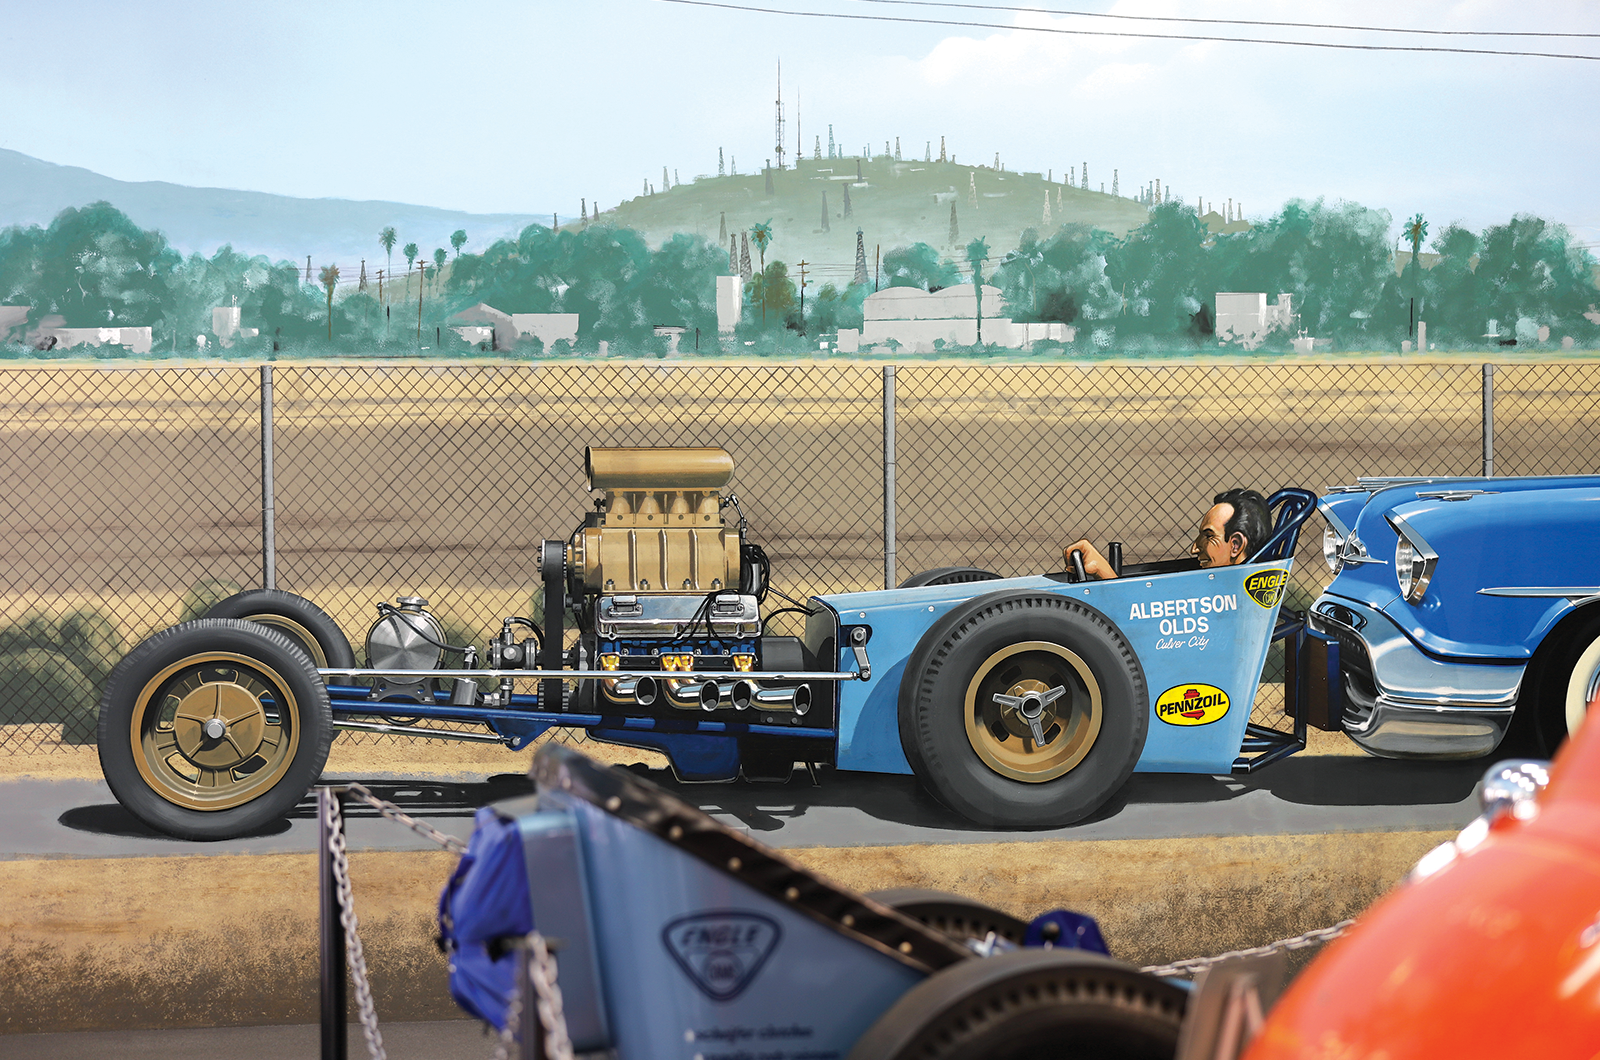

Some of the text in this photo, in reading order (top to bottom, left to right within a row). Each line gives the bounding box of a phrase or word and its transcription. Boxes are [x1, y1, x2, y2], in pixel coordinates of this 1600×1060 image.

[1248, 574, 1288, 591] ENGLE
[1129, 594, 1238, 620] ALBERTSON
[1159, 616, 1210, 636] OLDS
[1155, 635, 1210, 651] Culver City
[1159, 693, 1227, 717] PENNZOIL
[680, 924, 761, 946] ENGLE
